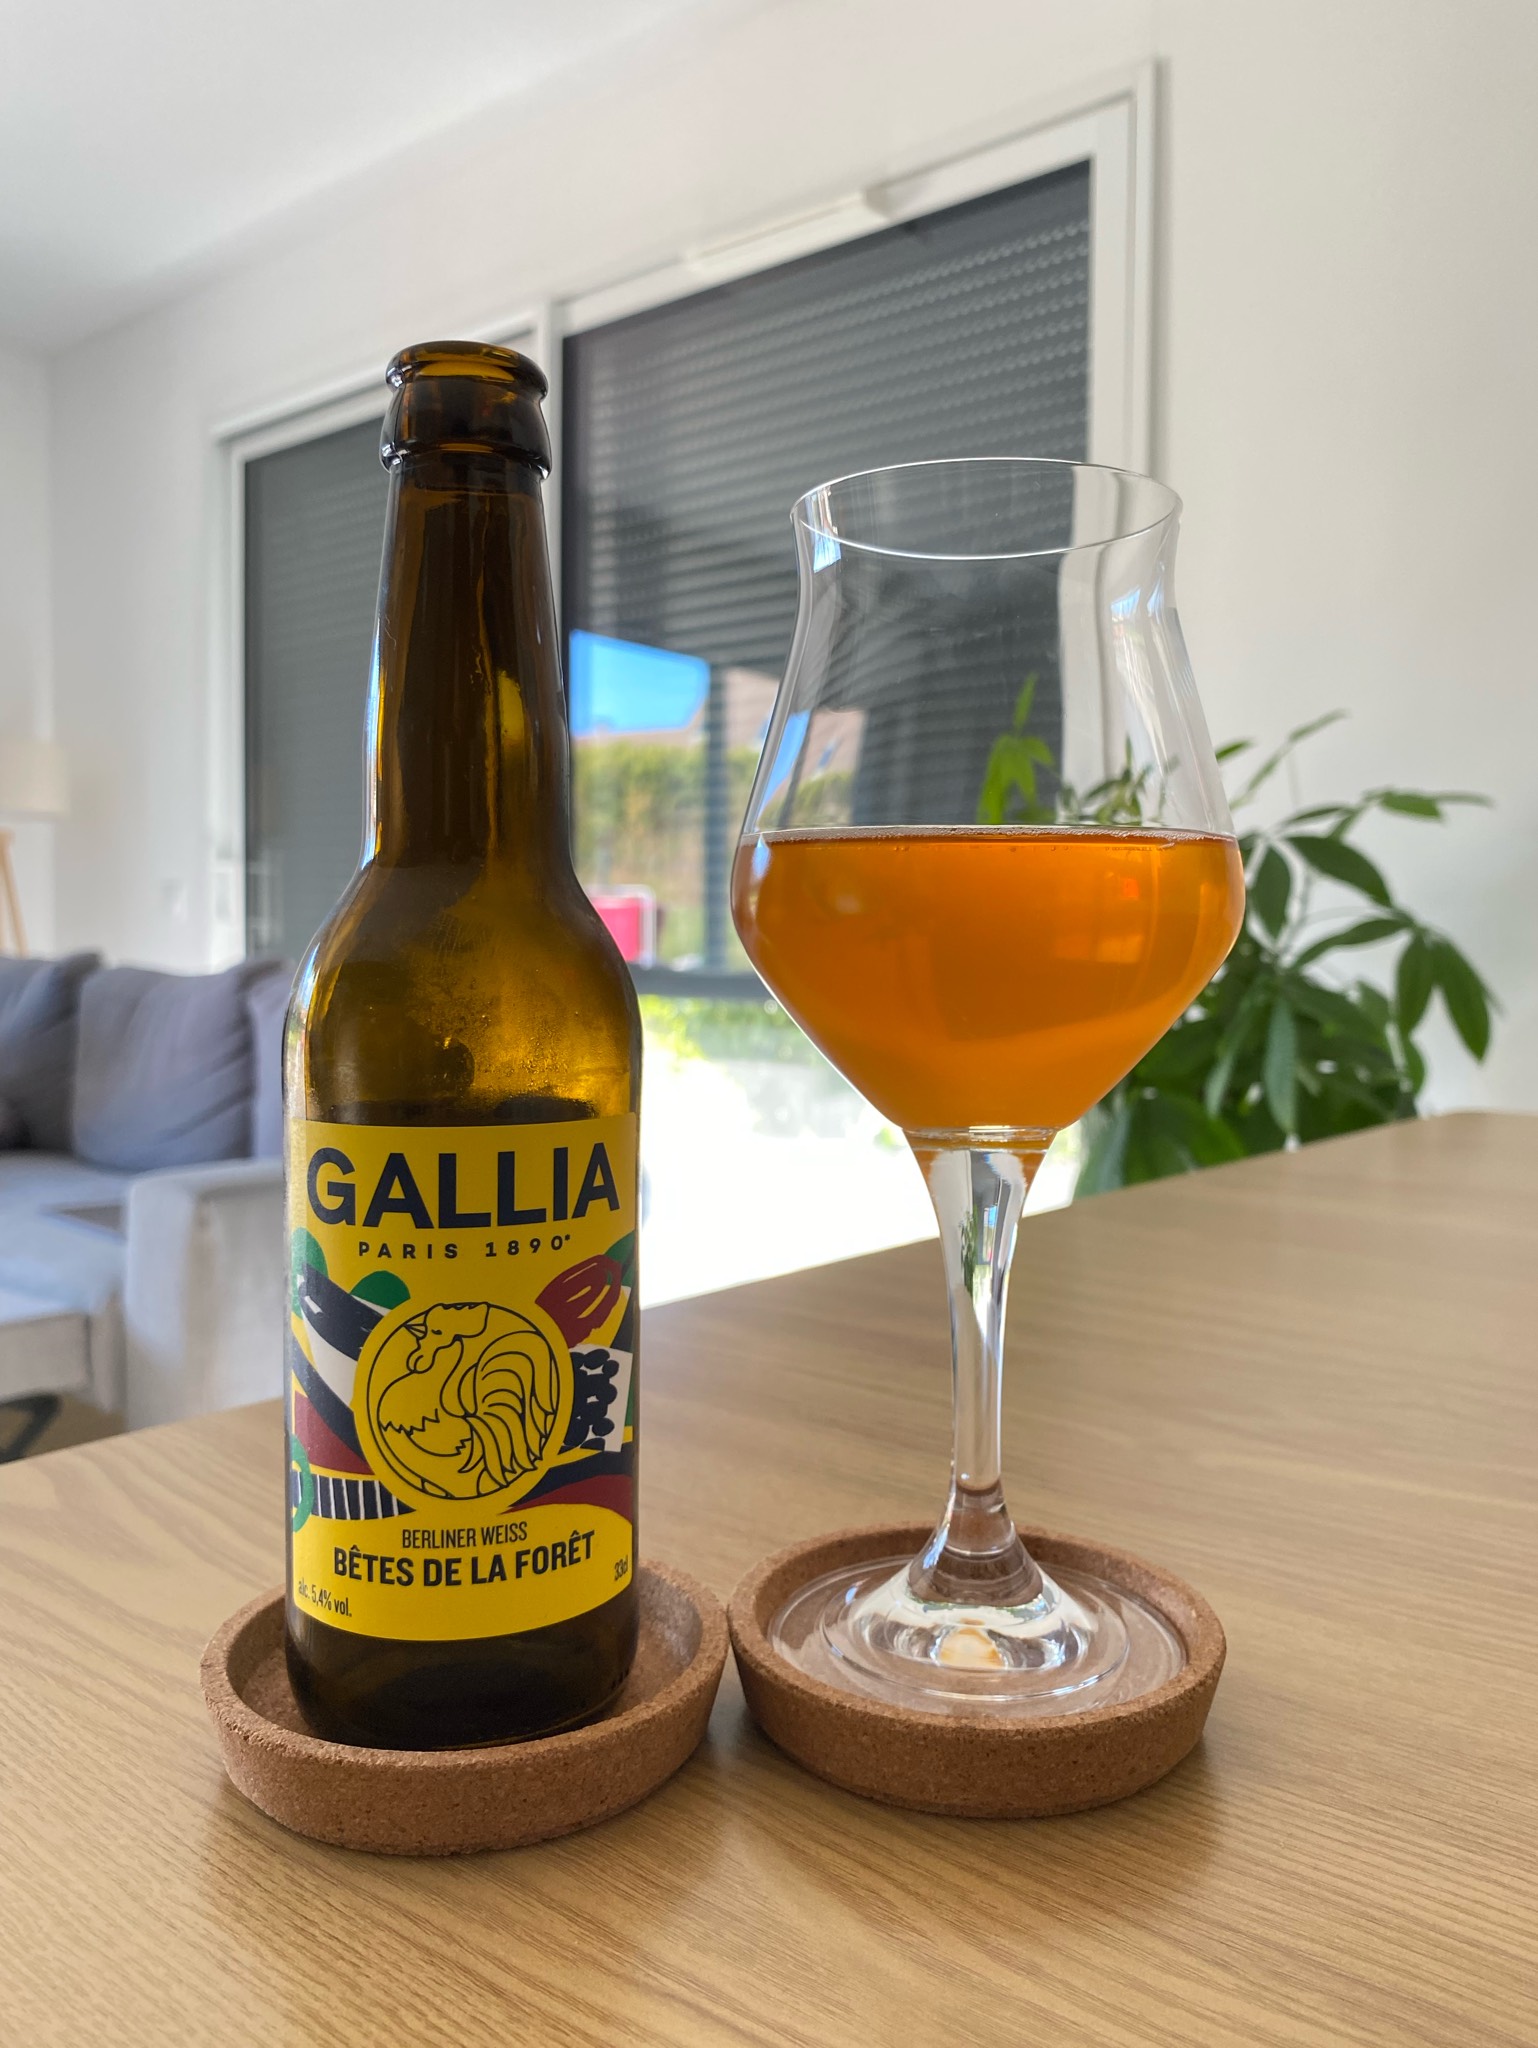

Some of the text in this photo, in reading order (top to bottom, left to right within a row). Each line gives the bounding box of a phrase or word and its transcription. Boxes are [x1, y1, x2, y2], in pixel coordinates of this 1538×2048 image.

[307, 1142, 620, 1229] GALLIA
[359, 1241, 458, 1259] PARIS
[402, 1521, 528, 1549] BERLINER WEISS
[333, 1530, 596, 1587] BÊTES DE LA FORÊT
[311, 1583, 333, 1611] 5,4%
[333, 1597, 353, 1618] vol.
